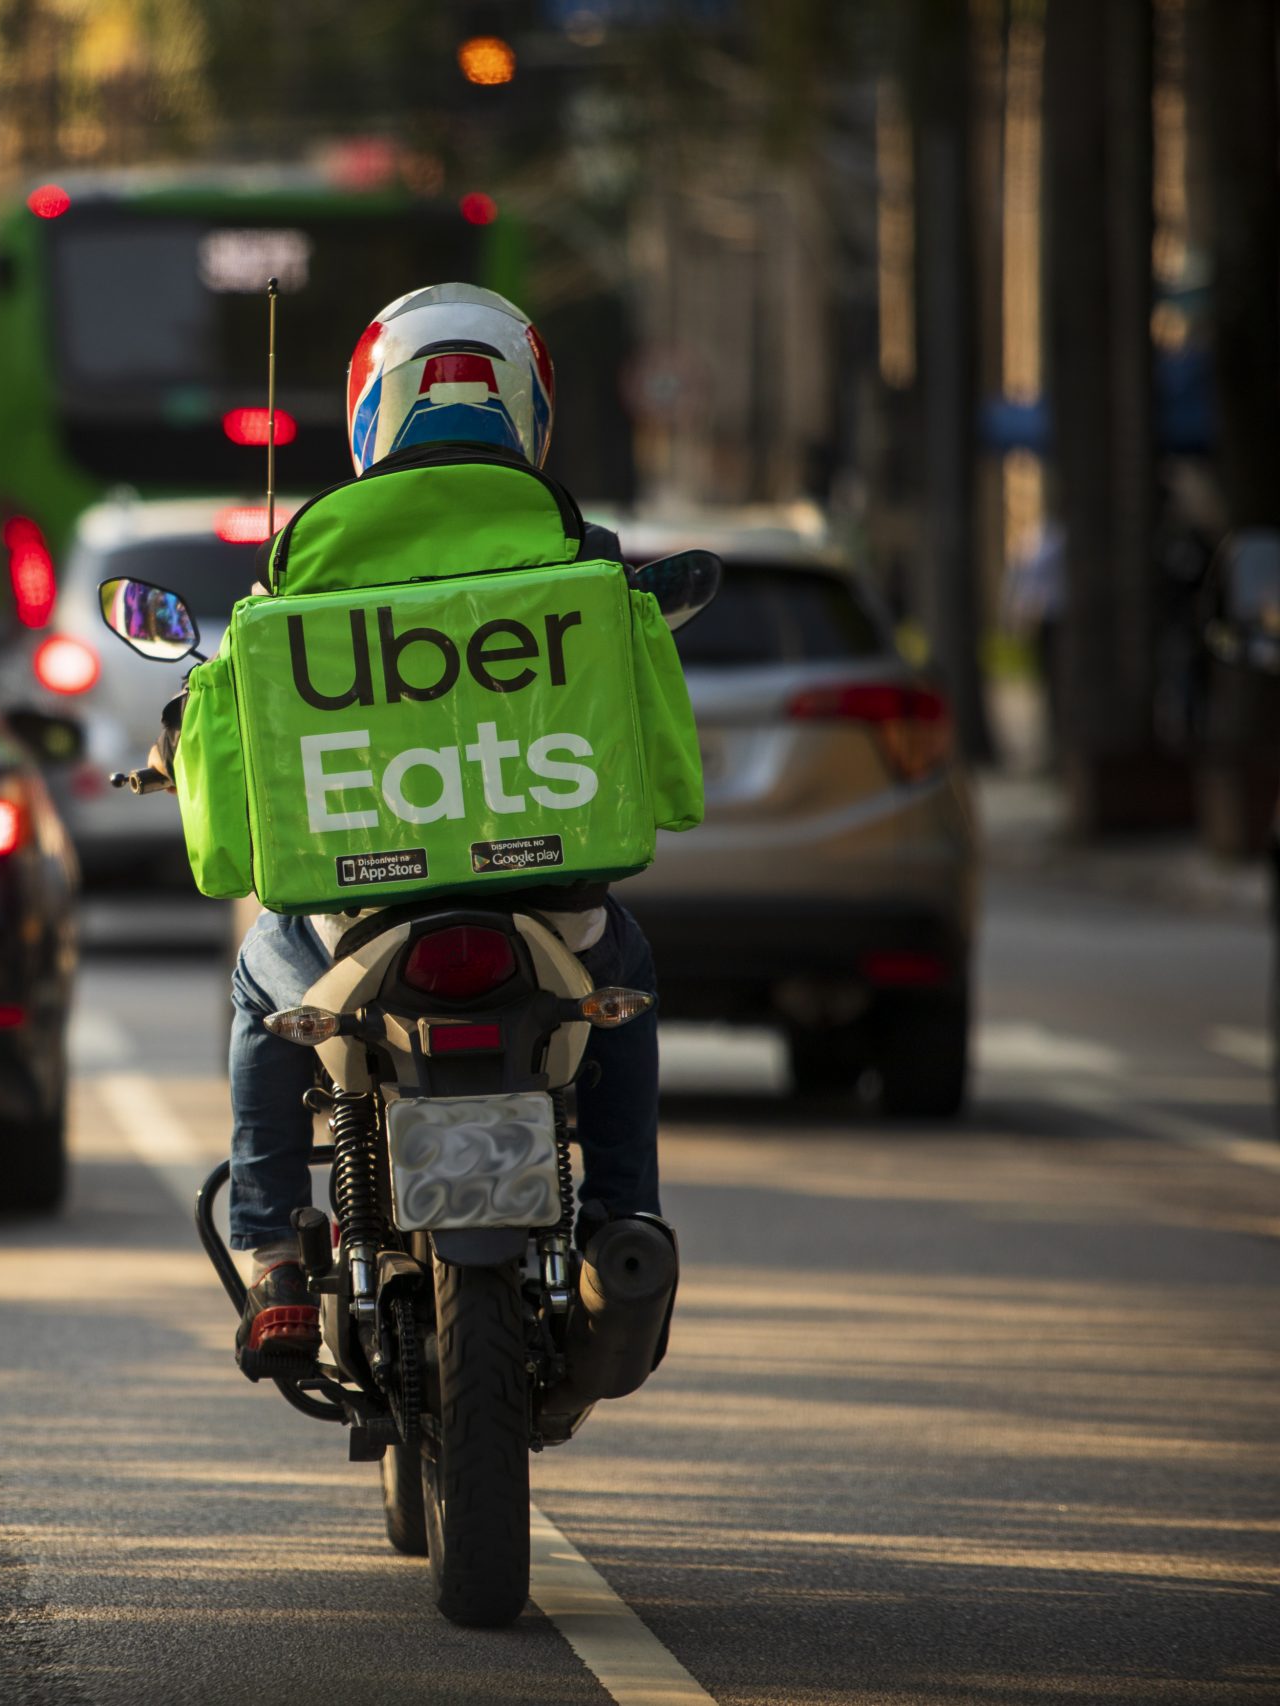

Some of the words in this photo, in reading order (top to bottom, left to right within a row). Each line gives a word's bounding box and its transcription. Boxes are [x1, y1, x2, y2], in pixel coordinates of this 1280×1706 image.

[286, 606, 582, 711] Uber
[300, 721, 599, 834] Eats
[491, 840, 532, 850] DISPONÍVEL
[492, 850, 535, 867] Google
[536, 849, 560, 863] play
[359, 866, 387, 881] App
[388, 863, 422, 877] Store
